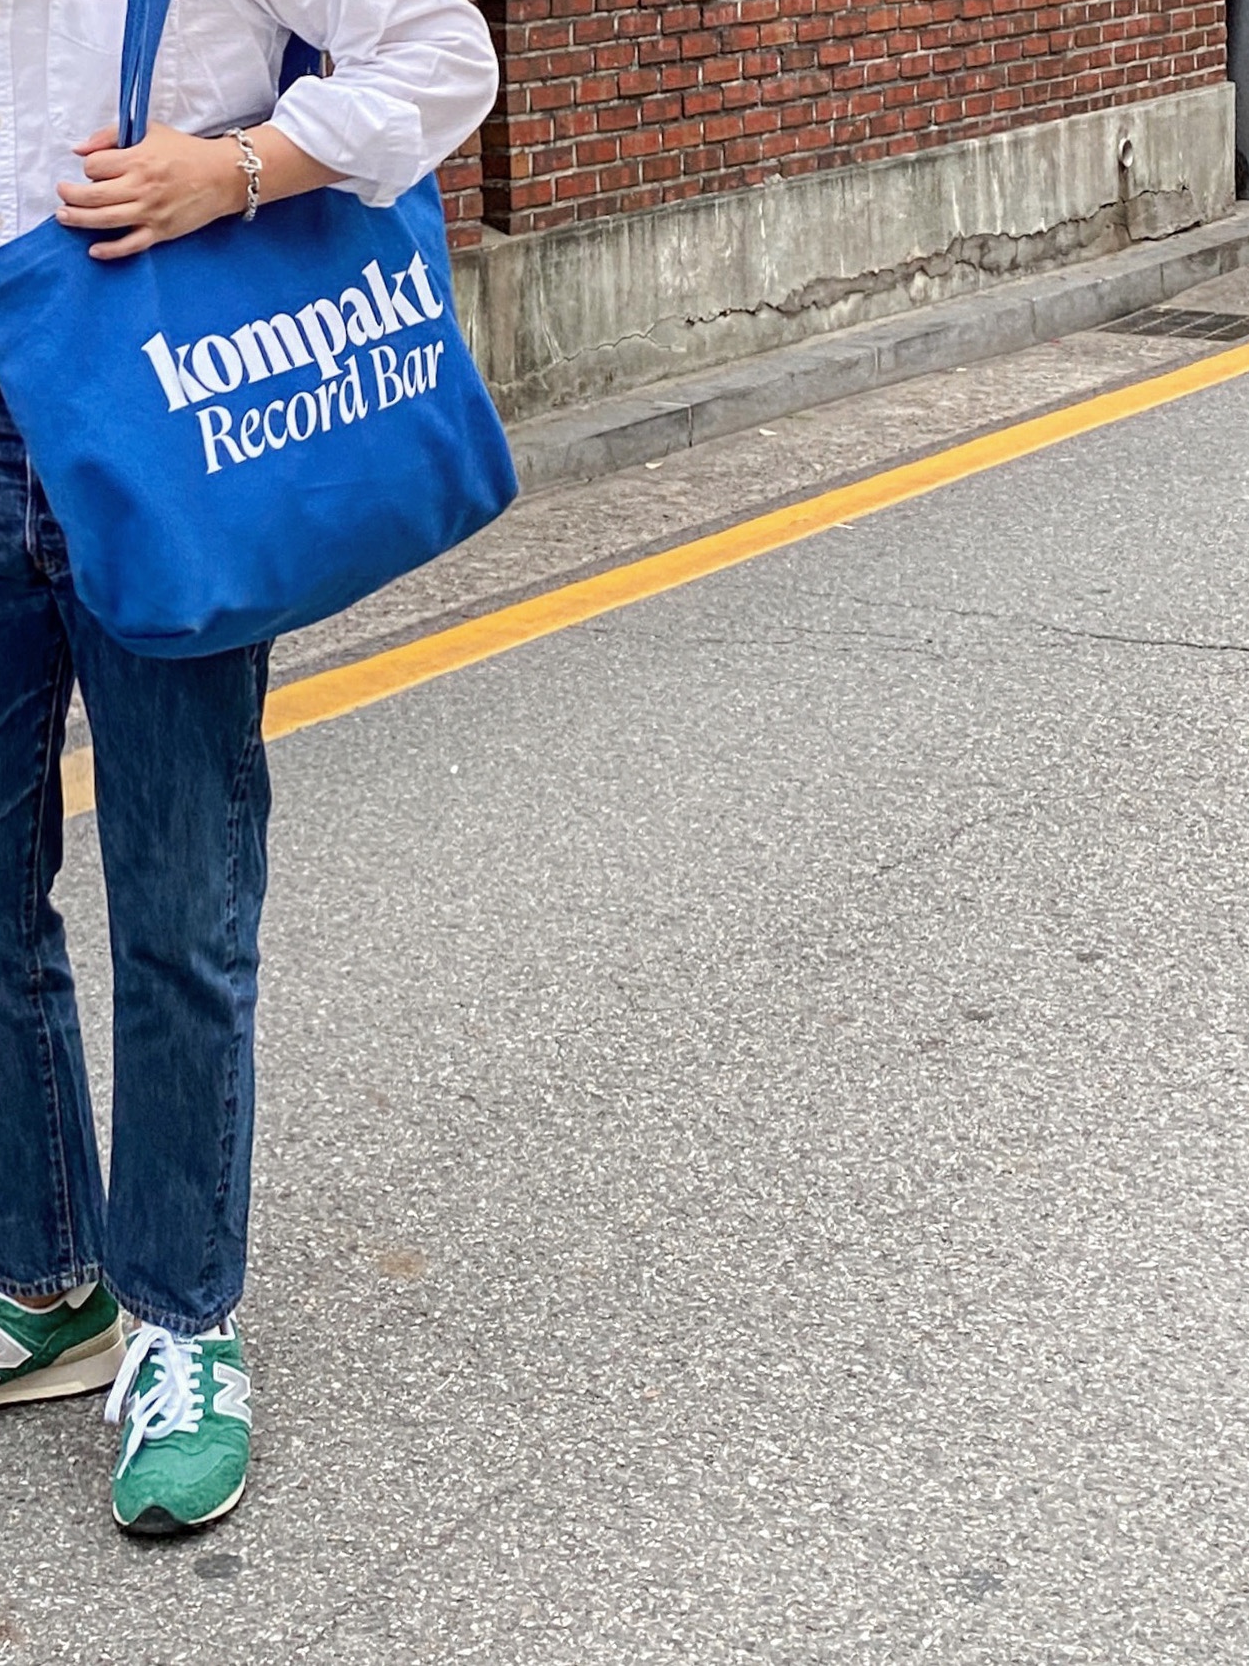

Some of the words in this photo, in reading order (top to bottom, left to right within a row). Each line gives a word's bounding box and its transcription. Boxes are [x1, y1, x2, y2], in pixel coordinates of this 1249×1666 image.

[141, 251, 444, 412] kompakt
[195, 355, 369, 474] Record
[369, 340, 444, 410] Bar
[213, 1361, 252, 1428] N
